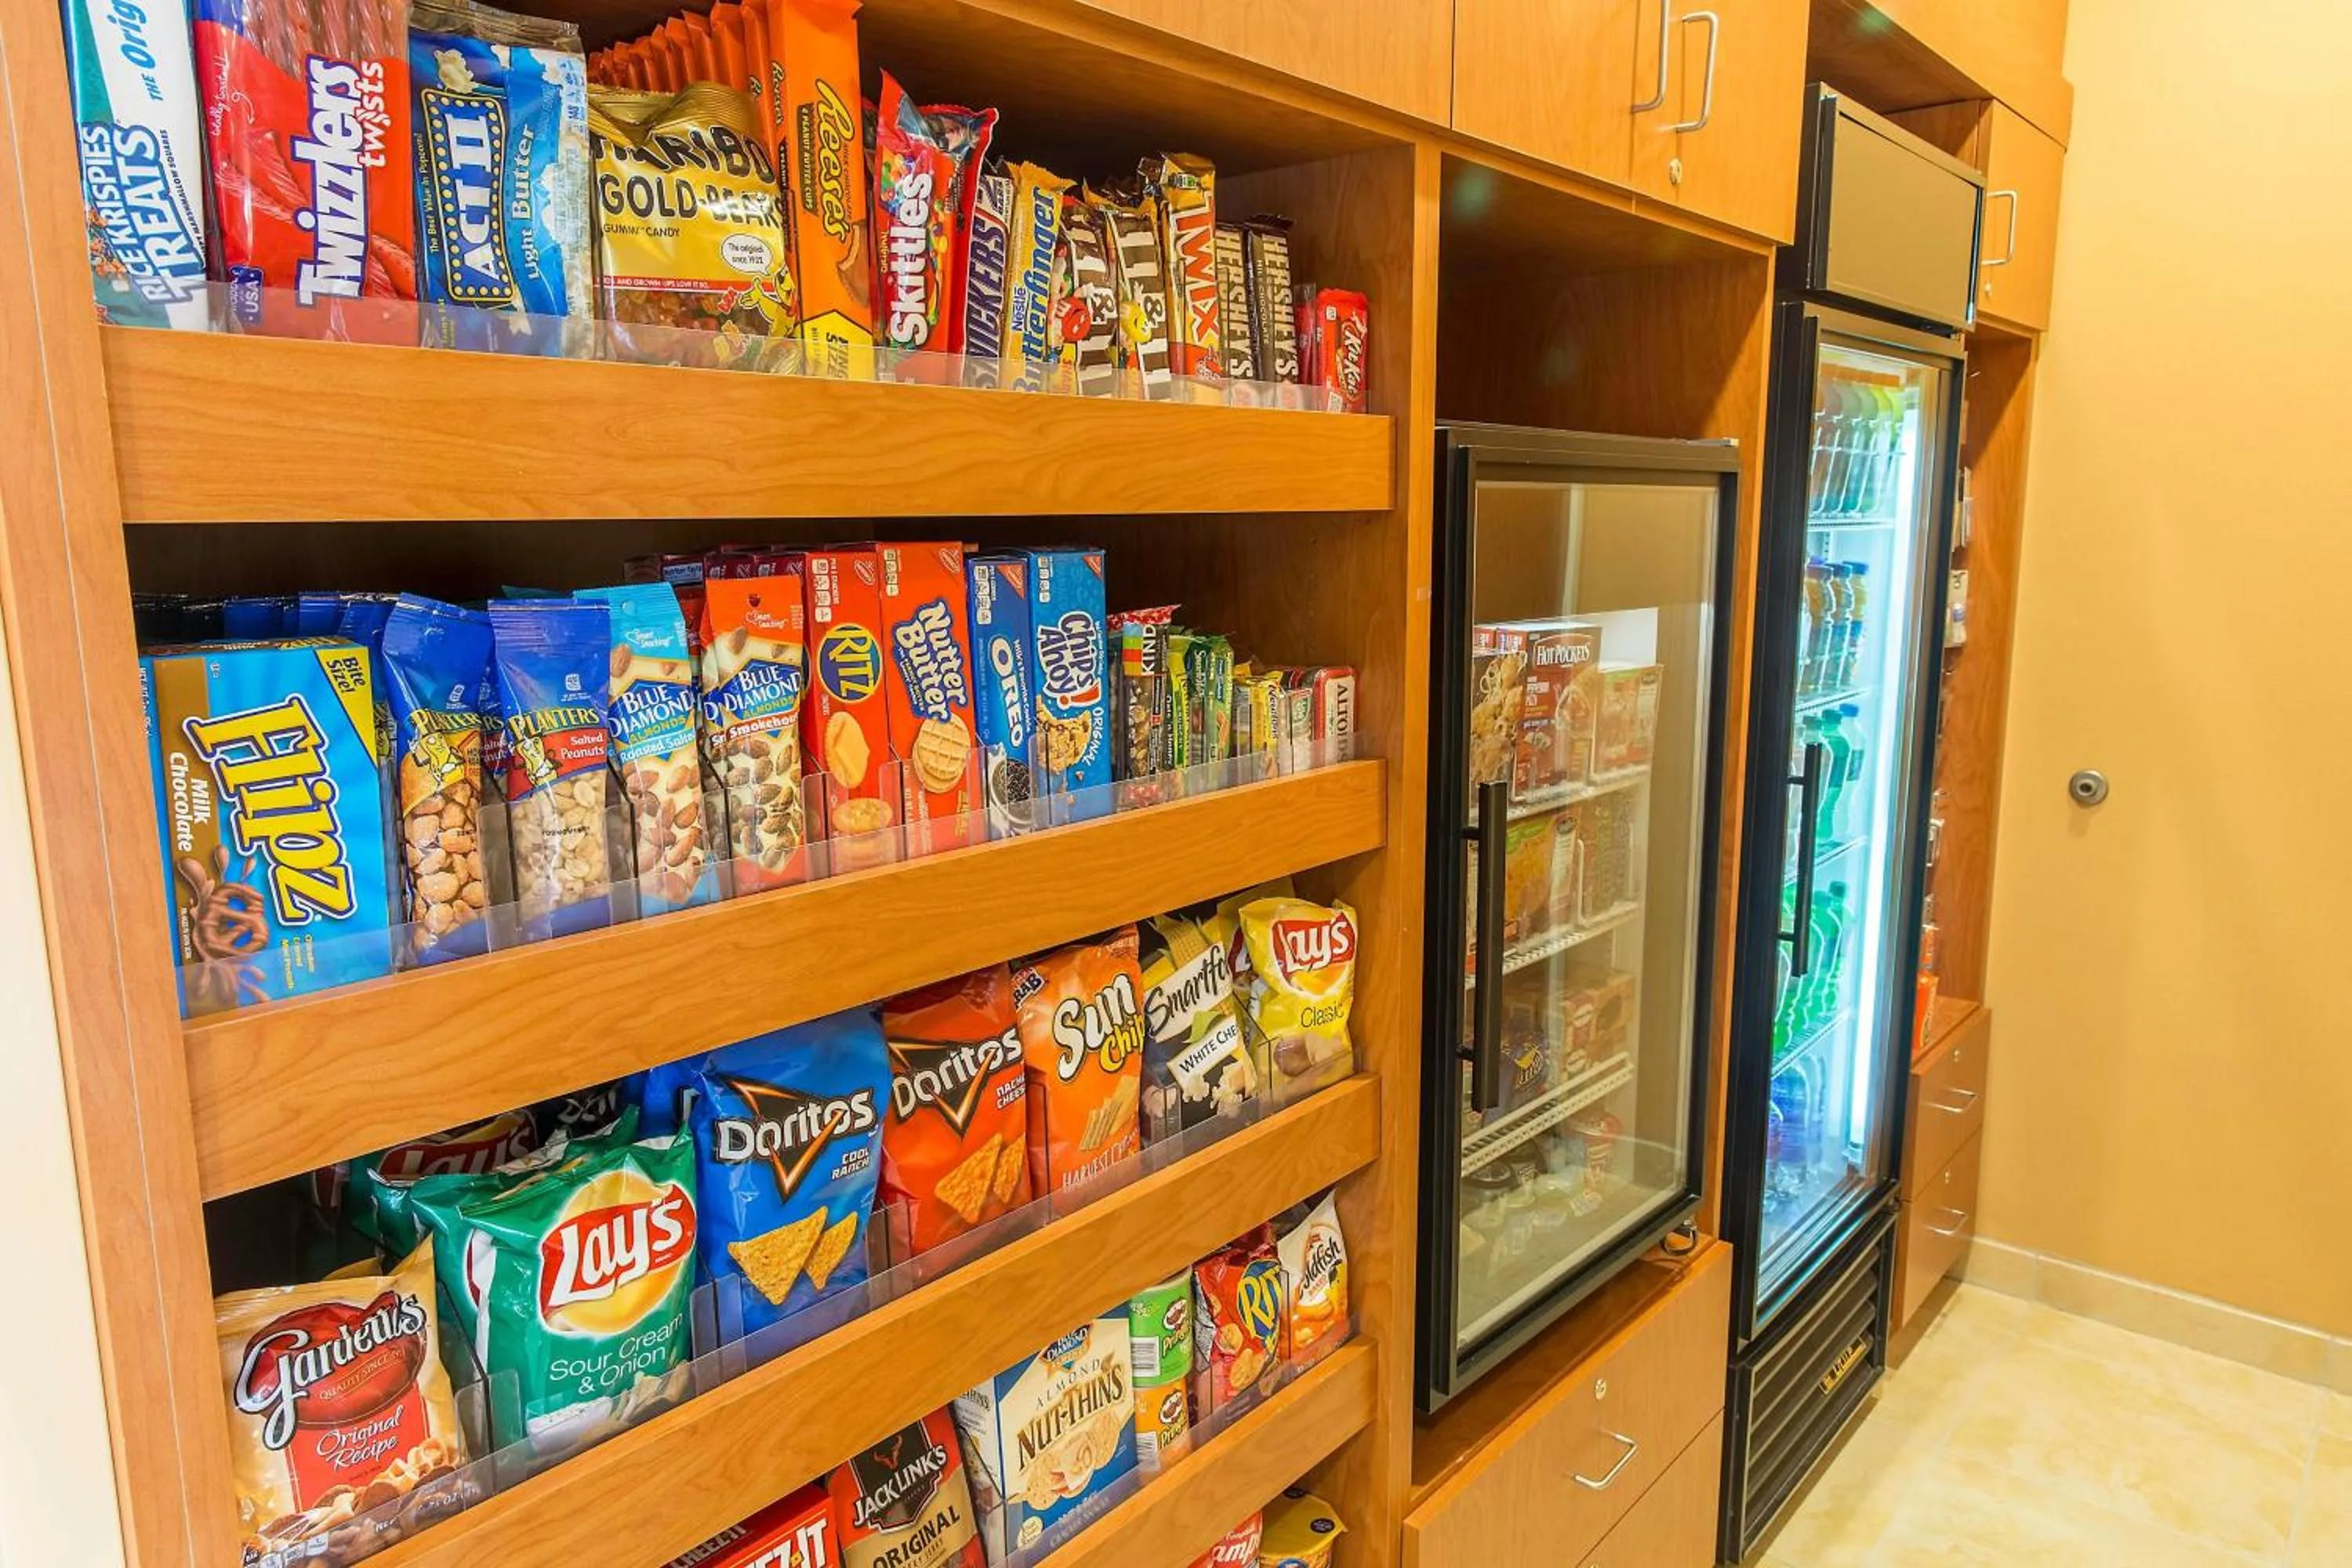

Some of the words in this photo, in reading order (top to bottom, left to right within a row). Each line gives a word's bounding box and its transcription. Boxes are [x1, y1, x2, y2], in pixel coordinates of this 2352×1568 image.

[141, 73, 163, 101] THE
[358, 60, 390, 168] twists
[82, 125, 139, 245] KRISPIES
[292, 59, 364, 304] Twizzlers
[512, 123, 535, 220] Butter
[815, 78, 855, 244] Reese's
[113, 129, 205, 299] TREATS
[455, 179, 500, 281] ACT
[117, 247, 172, 301] RICE
[890, 172, 934, 346] Skittles
[1171, 191, 1220, 346] TWIX
[245, 280, 260, 314] USA
[1216, 232, 1254, 377] HERSHEY'S
[1261, 234, 1299, 376] HERSHEY'S
[325, 659, 356, 694] Size!
[343, 656, 366, 687] Bite
[738, 665, 784, 691] BLUE
[826, 630, 874, 698] RITZ
[895, 620, 949, 721] Butter
[918, 601, 967, 705] Nutter
[1060, 612, 1097, 688] Chips
[1142, 624, 1156, 675] KIND
[509, 707, 601, 740] PLANTERS
[608, 688, 695, 739] DIAMOND
[622, 683, 673, 716] BLUE
[723, 671, 802, 712] DIAMOND
[990, 636, 1023, 747] OREO
[560, 746, 605, 760] Peanuts
[570, 733, 604, 745] Salted
[1081, 706, 1105, 766] ORIGINAL
[169, 751, 194, 853] Chocolate
[187, 695, 358, 924] Flipz
[191, 778, 212, 825] Milk
[1277, 915, 1350, 974] Lay's
[1012, 971, 1044, 1008] RAB
[1143, 944, 1230, 1037] Smartfo
[1300, 1000, 1345, 1029] Classic
[1054, 973, 1137, 1083] Sun
[1099, 1014, 1145, 1073] Chip
[1178, 1039, 1218, 1075] WHITE
[891, 1026, 1024, 1119] Doritos
[996, 1075, 1025, 1097] NACH
[996, 1087, 1026, 1111] CHEES
[717, 1091, 877, 1161] Doritos
[549, 1197, 684, 1307] Lay's
[1237, 1264, 1285, 1340] RIT
[549, 1351, 613, 1381] Sour
[619, 1313, 684, 1359] Cream
[578, 1376, 596, 1396] &
[600, 1345, 666, 1387] Onion
[1035, 1357, 1101, 1410] ALMOND
[316, 1403, 405, 1456] Original
[1016, 1364, 1125, 1473] NUT-THINS
[325, 1436, 400, 1472] Recipe
[853, 1480, 902, 1529] JACK
[894, 1444, 949, 1495] LINK'S
[871, 1504, 962, 1568] ORIGINAL
